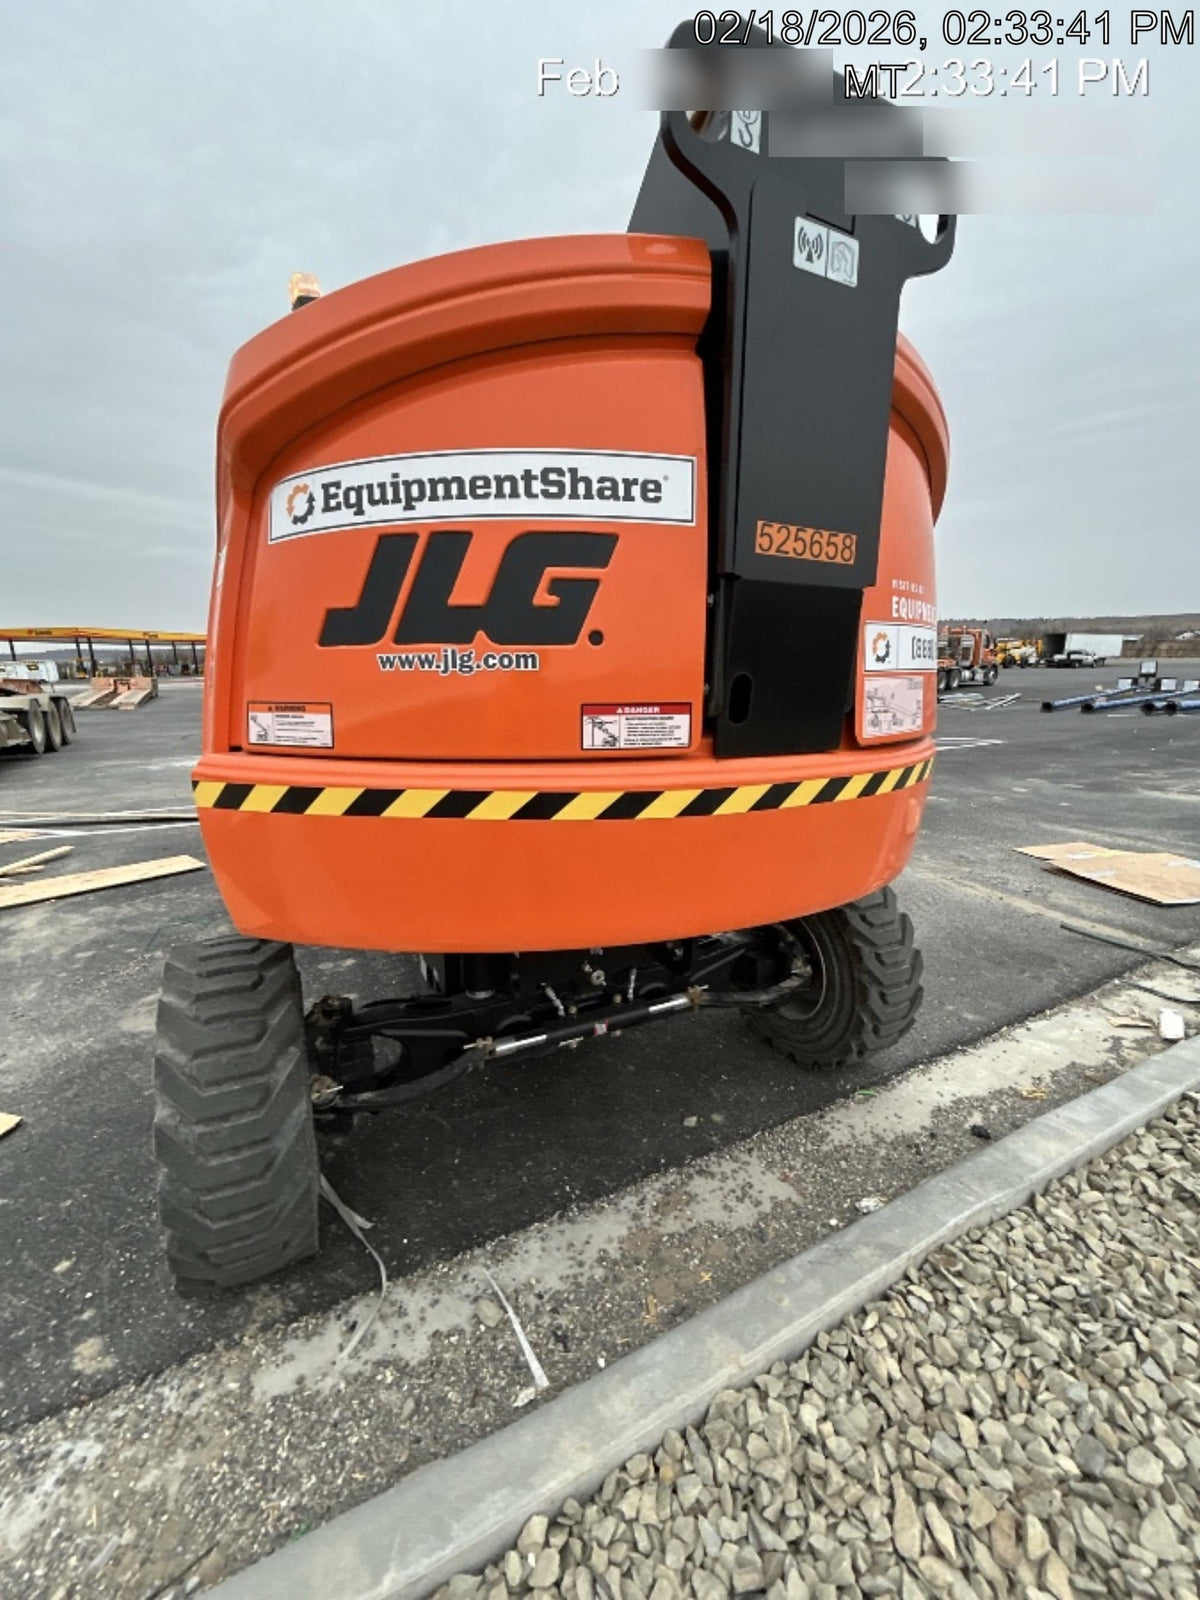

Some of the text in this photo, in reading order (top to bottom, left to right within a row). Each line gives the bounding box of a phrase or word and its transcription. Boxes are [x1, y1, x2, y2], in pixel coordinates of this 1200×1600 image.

[321, 466, 663, 516] EquipmentShare
[757, 521, 855, 563] 525658
[378, 648, 539, 674] www.jlg.com
[623, 706, 661, 714] DANGER
